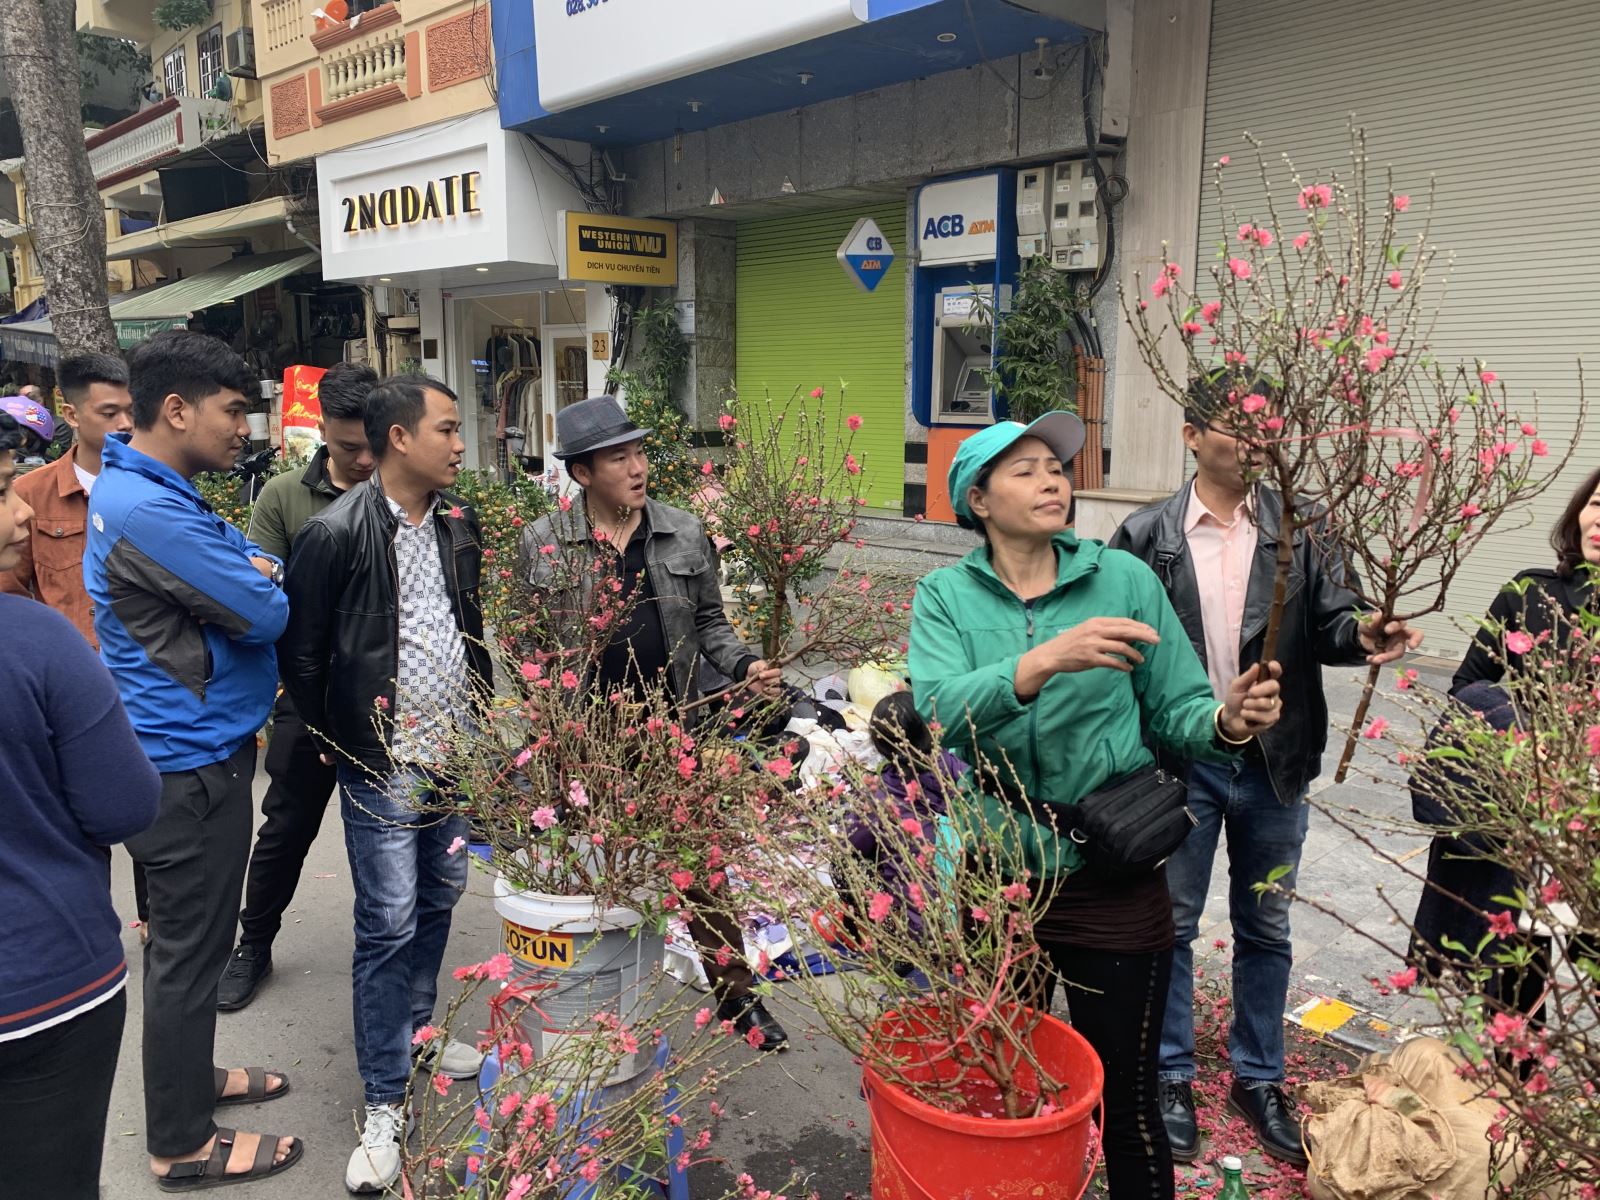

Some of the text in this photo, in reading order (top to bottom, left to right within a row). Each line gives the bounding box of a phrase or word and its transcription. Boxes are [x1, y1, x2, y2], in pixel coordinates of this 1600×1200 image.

[923, 214, 995, 240] ACB ATM
[581, 229, 631, 242] WESTERN
[597, 240, 631, 251] UNION
[635, 234, 662, 254] WU
[861, 260, 881, 270] ATM
[593, 339, 606, 353] 23
[506, 925, 567, 963] JOTUN
